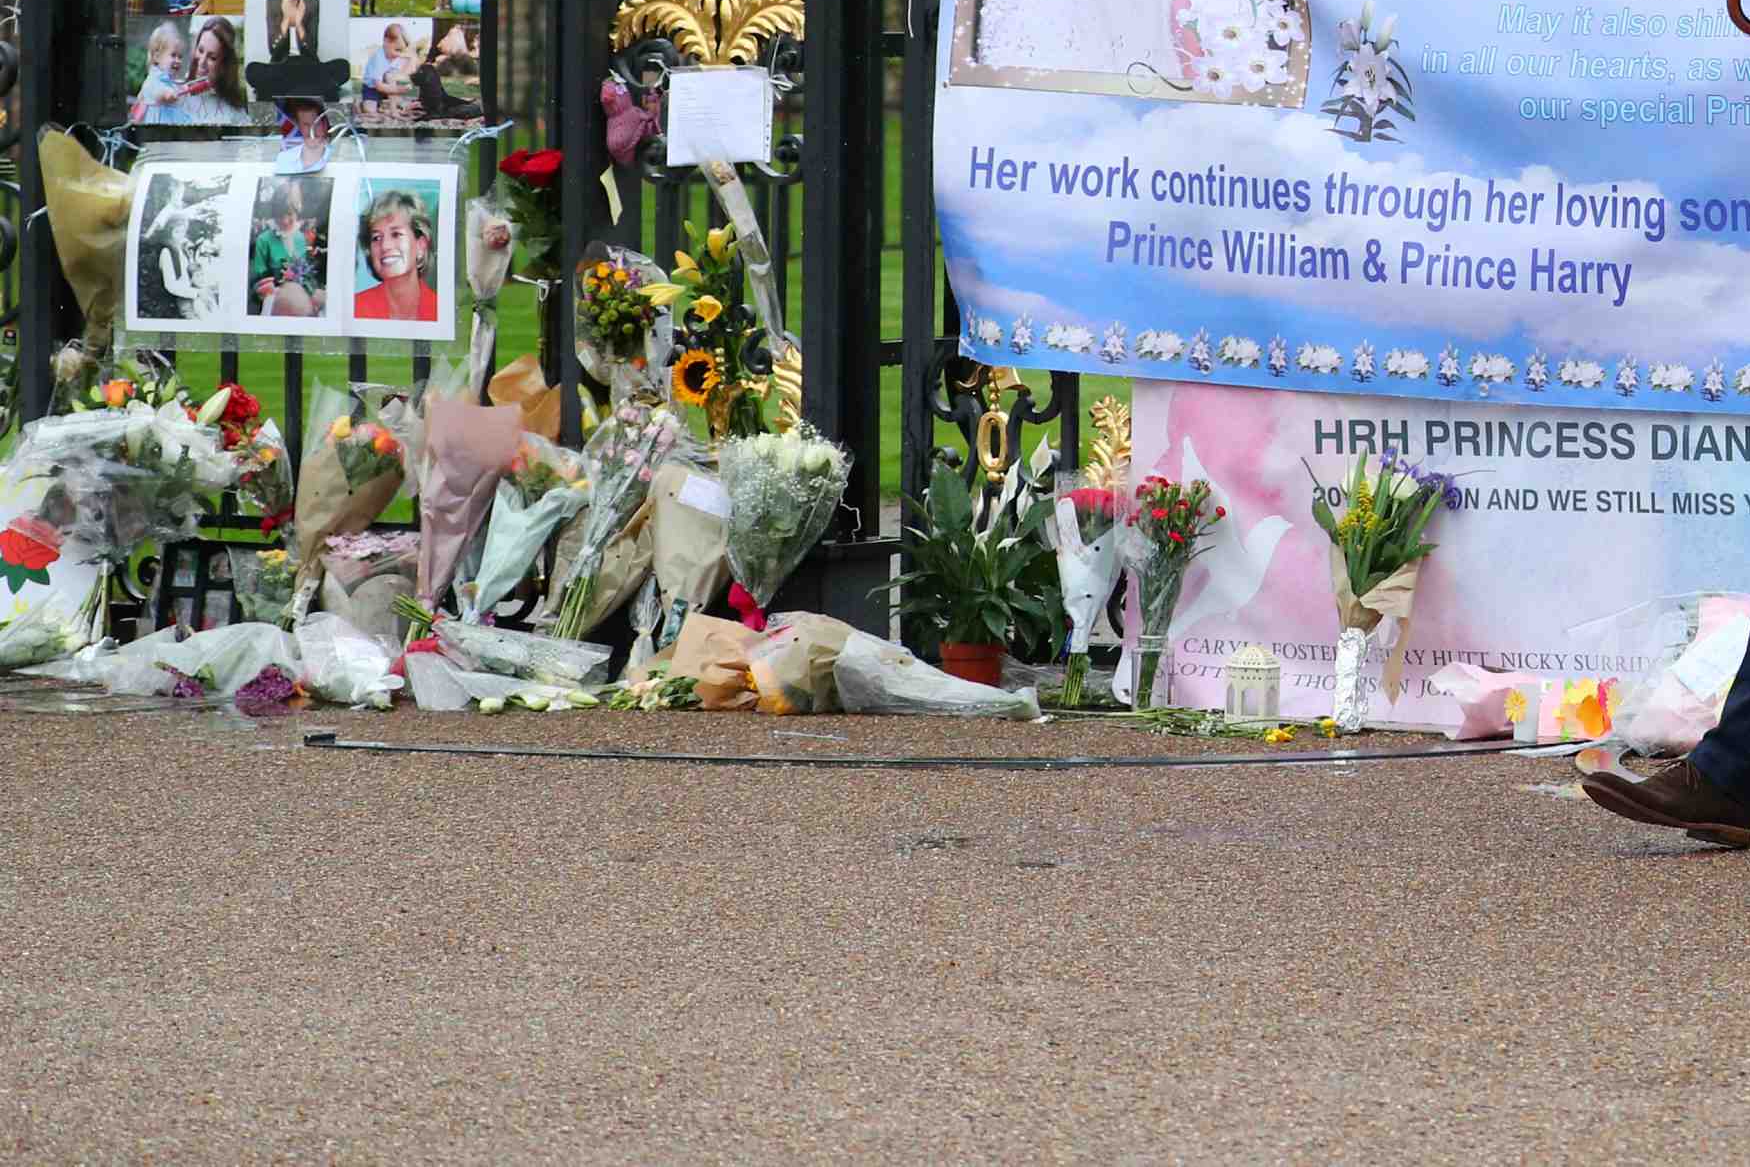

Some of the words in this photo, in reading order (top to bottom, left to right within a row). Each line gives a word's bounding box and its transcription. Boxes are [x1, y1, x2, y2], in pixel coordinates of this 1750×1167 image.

[1497, 2, 1563, 42] May
[1571, 5, 1593, 36] it
[1601, 7, 1667, 37] also
[1420, 42, 1449, 74] in
[1458, 44, 1498, 75] all
[1506, 53, 1561, 78] our
[1569, 49, 1676, 83] hearts,
[1687, 56, 1723, 82] as
[1519, 96, 1572, 121] our
[1580, 93, 1695, 130] special
[968, 145, 1037, 193] Her
[1048, 156, 1139, 200] work
[1151, 164, 1311, 213] continues
[1324, 172, 1472, 232] through
[1484, 176, 1545, 226] her
[1555, 182, 1666, 243] loving
[1105, 220, 1214, 272] Prince
[1221, 228, 1351, 282] William
[1362, 238, 1389, 284] &
[1400, 241, 1517, 291] Prince
[1530, 248, 1633, 308] Harry
[1314, 419, 1409, 455] HRH
[1425, 420, 1637, 461] PRINCESS
[1487, 489, 1538, 511] AND
[1548, 490, 1588, 512] WE
[1596, 491, 1665, 514] STILL
[1672, 492, 1736, 516] MISS
[1272, 642, 1338, 662] FOSTE
[1500, 651, 1568, 671] NICKY
[1574, 653, 1662, 673] SURRID
